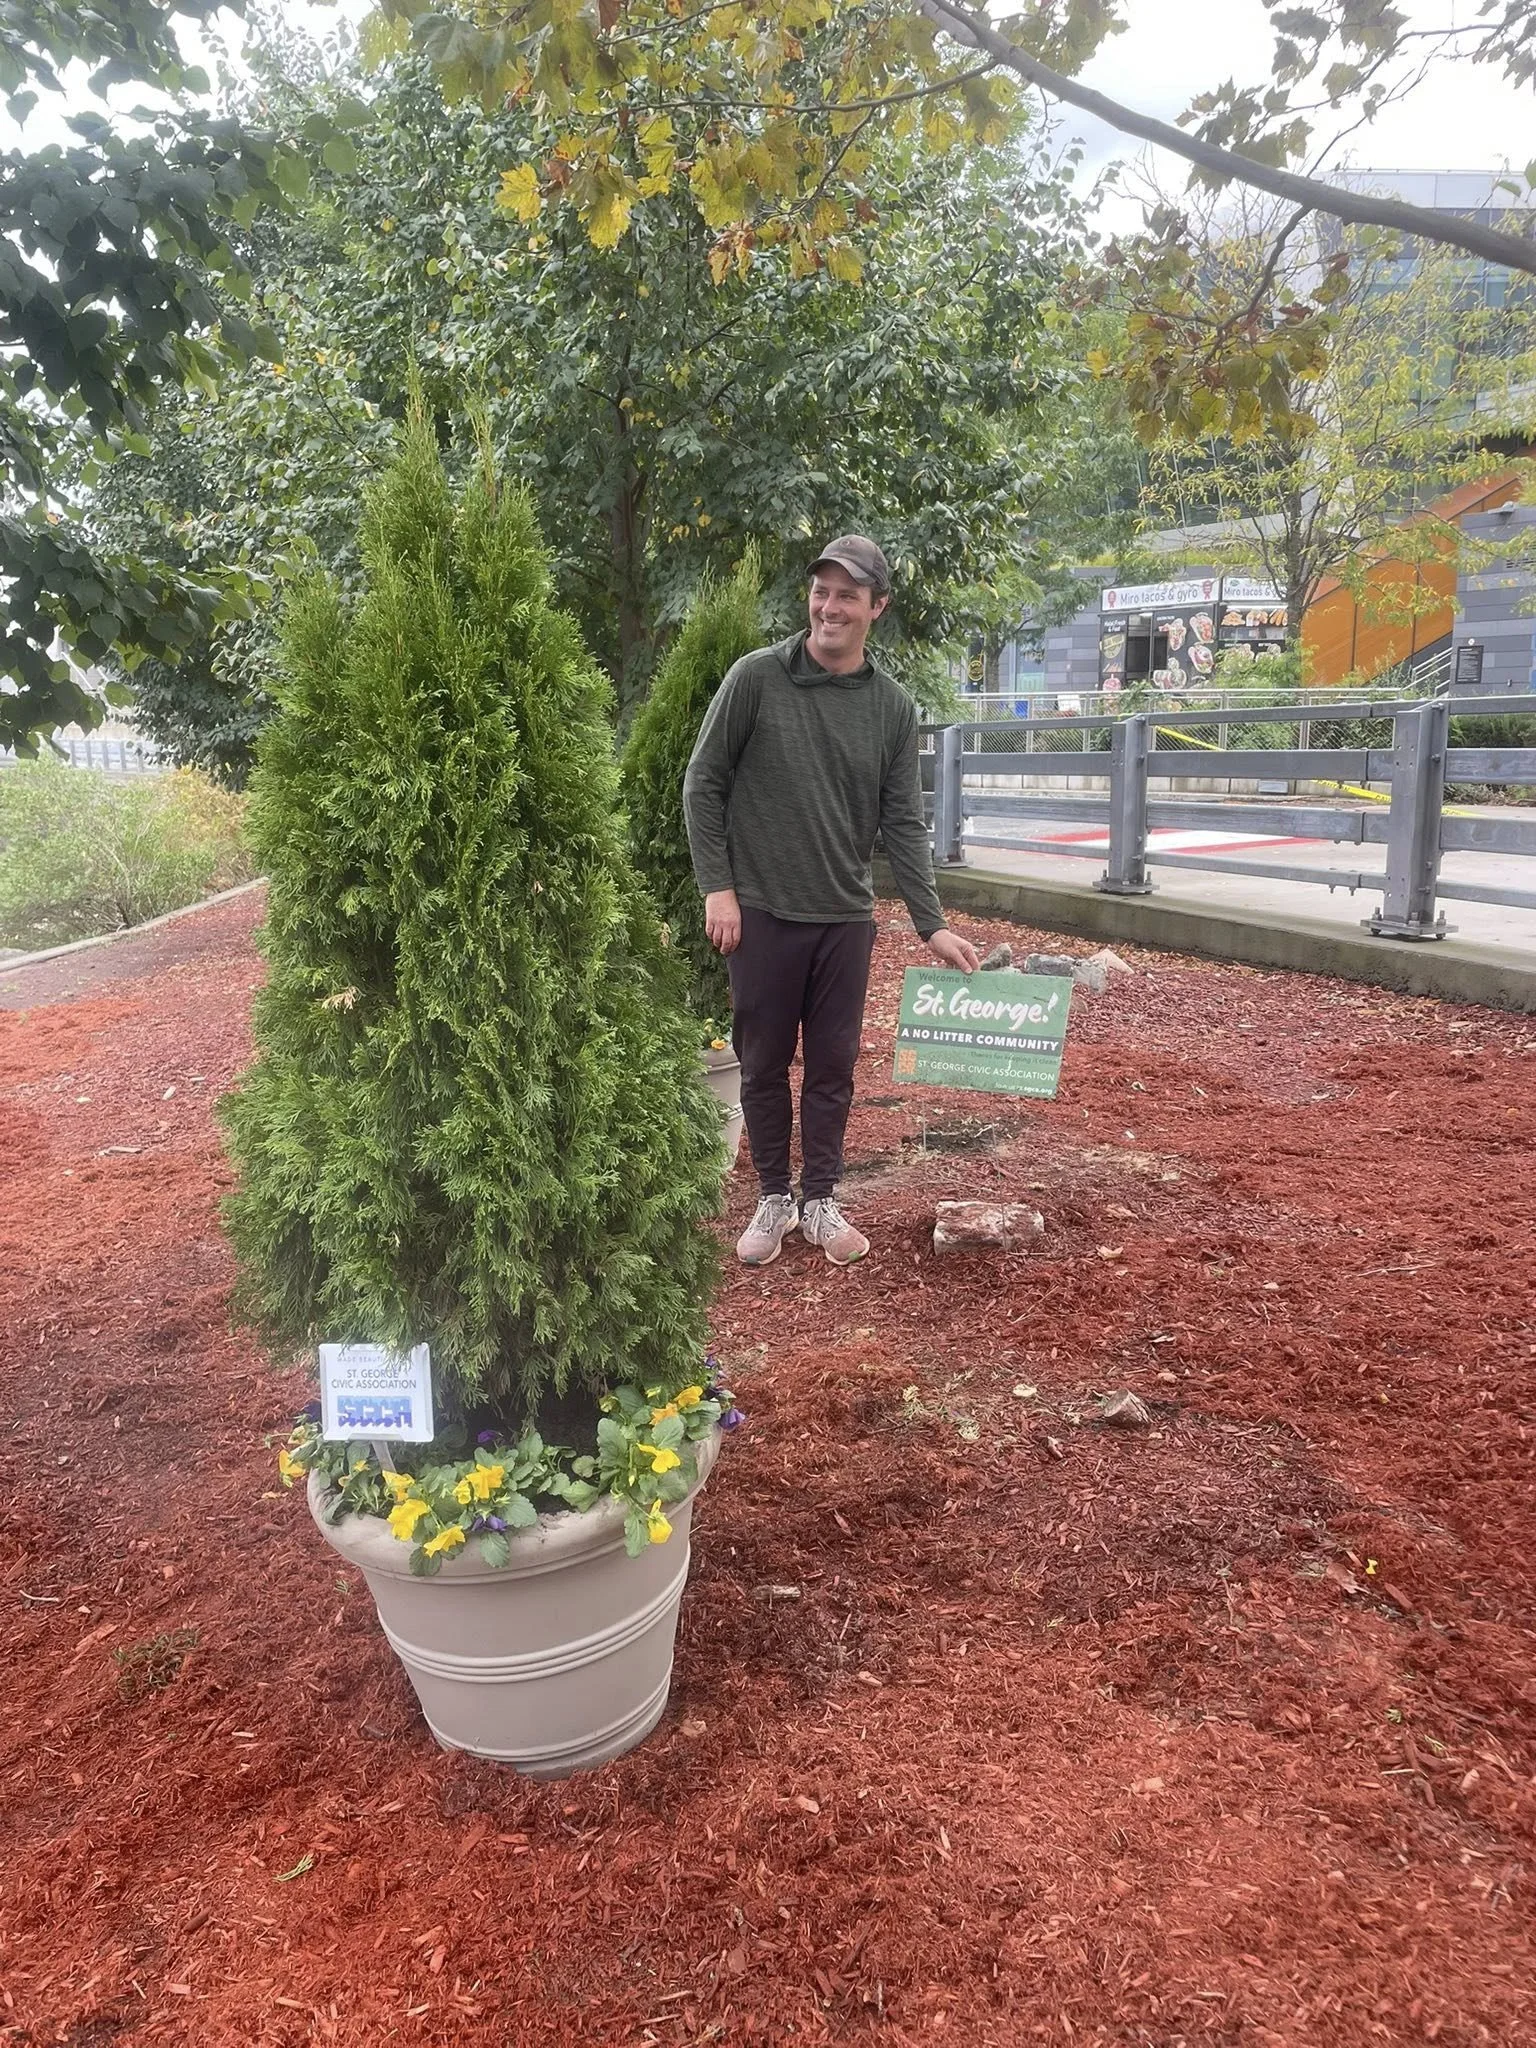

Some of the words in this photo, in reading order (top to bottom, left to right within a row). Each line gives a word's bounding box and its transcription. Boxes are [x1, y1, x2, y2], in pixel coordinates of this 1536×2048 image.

[1120, 593, 1139, 606] Miro
[1141, 591, 1165, 602] tacos
[1168, 589, 1174, 600] &
[1177, 588, 1198, 602] gyro
[1224, 587, 1240, 597] Miro
[1242, 587, 1263, 597] tacos
[919, 973, 960, 984] Welcome
[963, 975, 973, 984] to
[912, 984, 945, 1016] St.
[949, 986, 1059, 1031] George!
[901, 1028, 910, 1037] A
[913, 1029, 930, 1039] NO
[933, 1030, 973, 1044] LITTER
[976, 1034, 1059, 1051] COMMUNITY
[931, 1060, 966, 1072] GEORGE
[968, 1065, 992, 1075] CIVIC
[993, 1067, 1055, 1081] ASSOCIATION
[347, 1369, 359, 1379] ST.
[361, 1369, 399, 1379] GEORGE
[331, 1380, 354, 1389] CIVIC
[356, 1380, 417, 1389] ASSOCIATION
